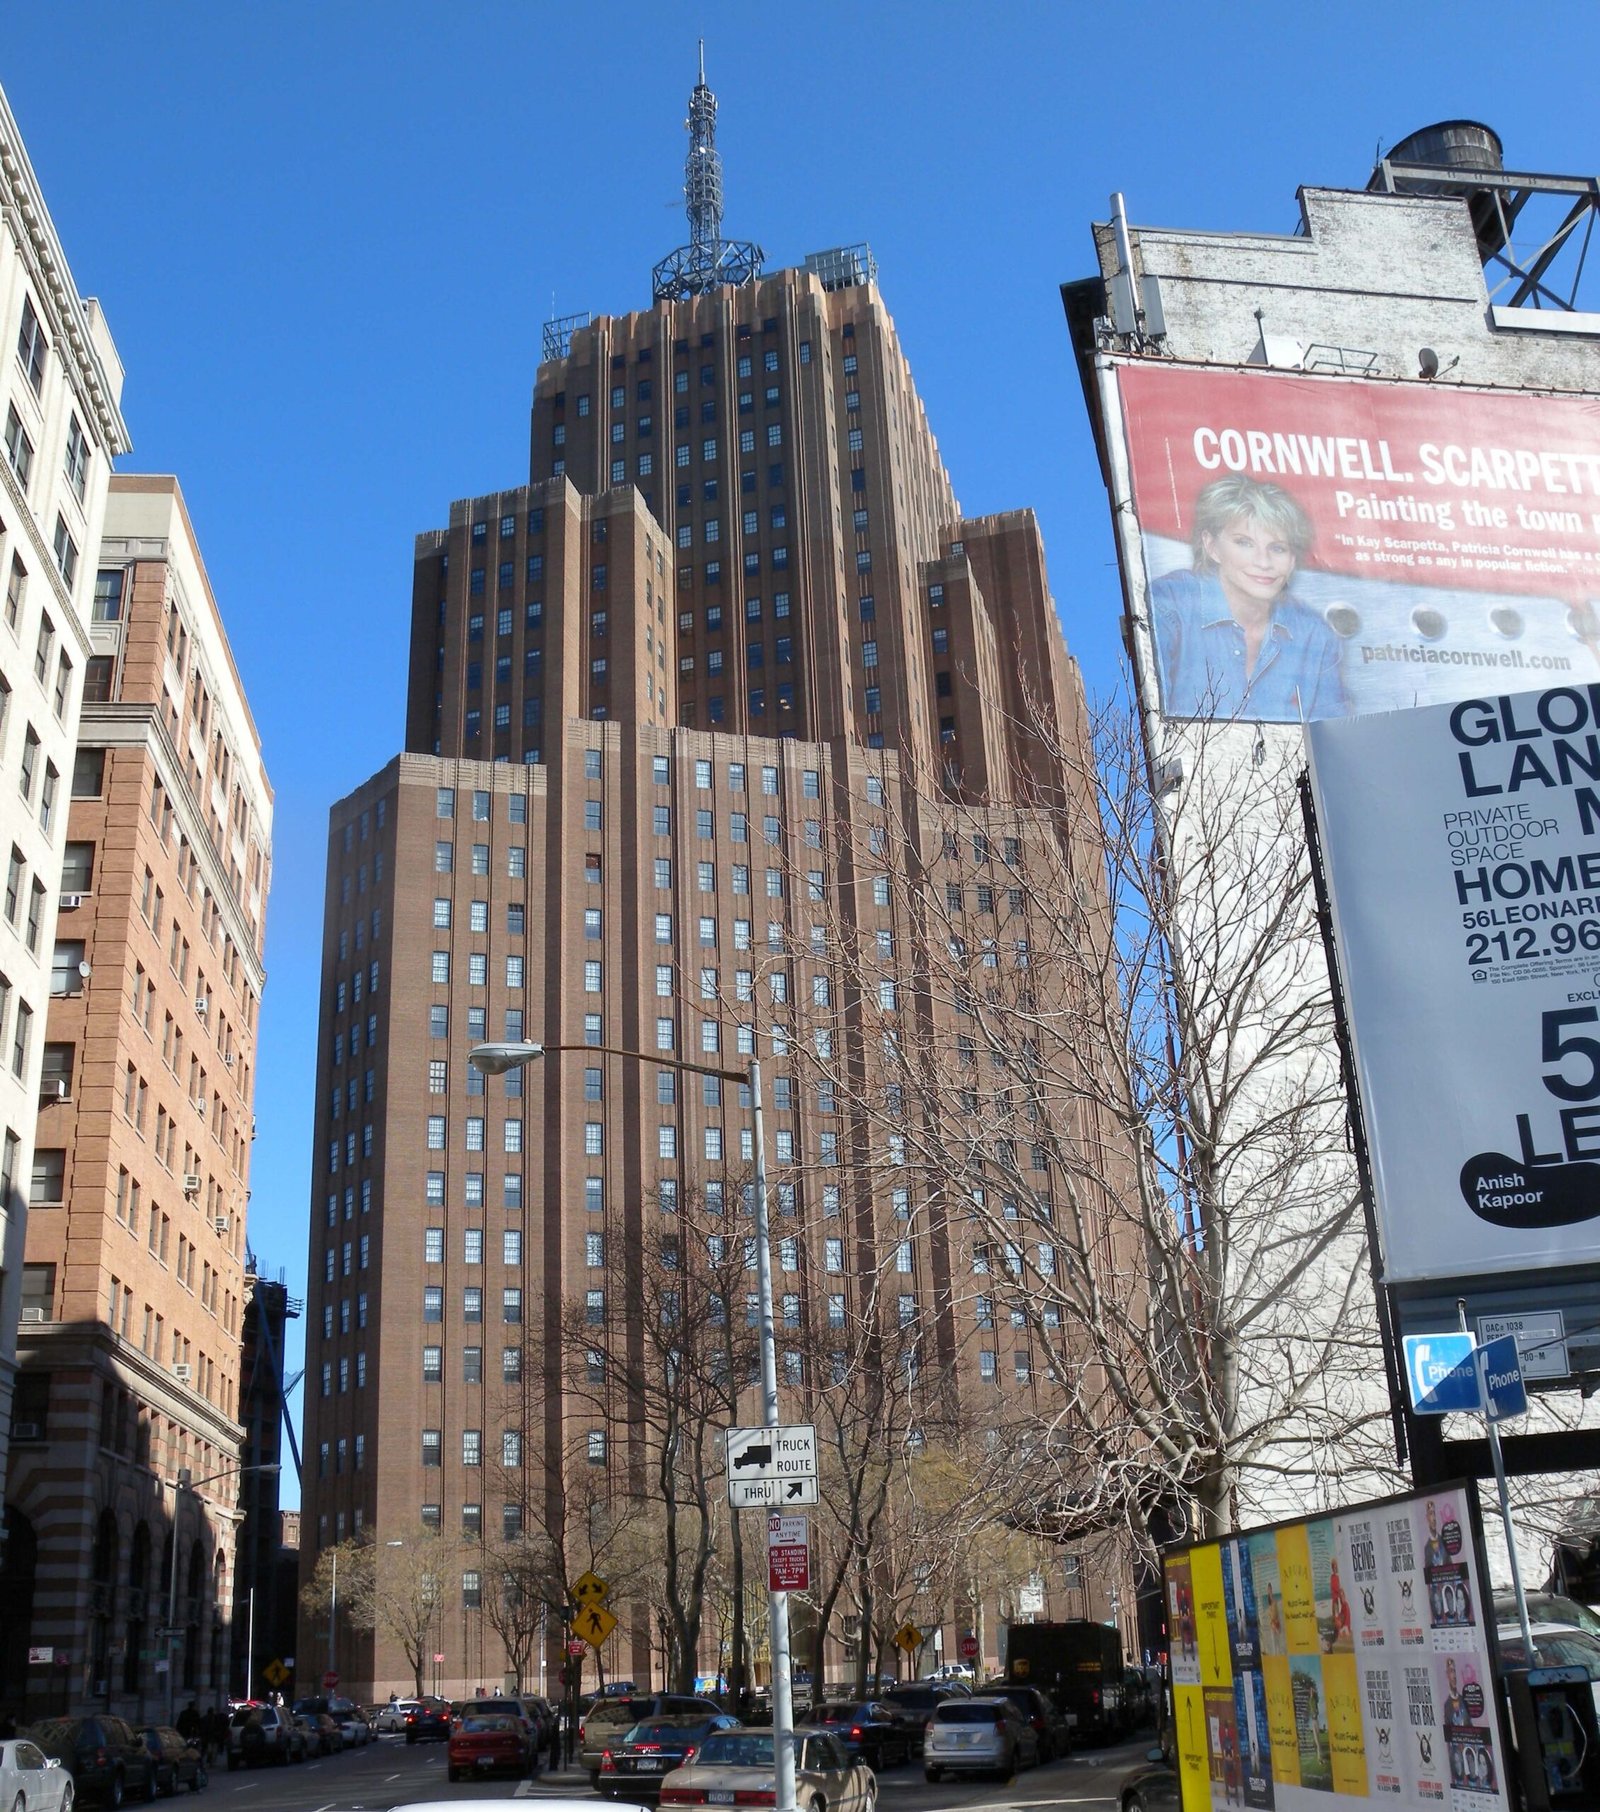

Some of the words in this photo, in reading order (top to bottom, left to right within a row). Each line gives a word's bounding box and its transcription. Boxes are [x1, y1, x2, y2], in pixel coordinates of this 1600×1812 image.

[1193, 427, 1414, 482] CORNWELL.
[1335, 490, 1456, 531] Painting
[1461, 500, 1508, 529] the
[1516, 503, 1583, 533] town
[1356, 535, 1380, 550] Kay
[1384, 537, 1449, 553] Scarpetta,
[1452, 541, 1500, 555] Patricia
[1503, 545, 1556, 559] Cornwell
[1560, 548, 1581, 560] has
[1355, 551, 1370, 561] as
[1374, 551, 1415, 567] strong
[1418, 555, 1432, 566] as
[1436, 556, 1457, 569] any
[1461, 556, 1473, 568] in
[1476, 558, 1520, 571] popular
[1361, 644, 1571, 671] patriciacornwell.com
[1458, 734, 1600, 798] LAN
[1443, 803, 1532, 830] PRIVATE
[1447, 819, 1559, 848] OUTDOOR
[1451, 842, 1524, 866] SPACE
[1454, 852, 1600, 905] HOME
[1462, 895, 1600, 930] 56LEONAR
[1465, 919, 1600, 965] 212.96
[1567, 989, 1600, 1003] EXCL
[1541, 1005, 1600, 1102] 5
[1516, 1105, 1600, 1167] LE
[1476, 1172, 1525, 1192] Anish
[1478, 1191, 1544, 1209] Kapoor
[1506, 1321, 1524, 1331] 1038
[1428, 1365, 1474, 1380] Phone
[1488, 1369, 1520, 1391] Phone
[776, 1439, 811, 1452] TRUCK
[777, 1460, 811, 1472] ROUTE
[744, 1487, 771, 1499] THRU
[769, 1519, 780, 1530] NO
[781, 1549, 806, 1557] STANDING
[1351, 1540, 1376, 1572] BEING
[961, 1643, 978, 1652] STOP
